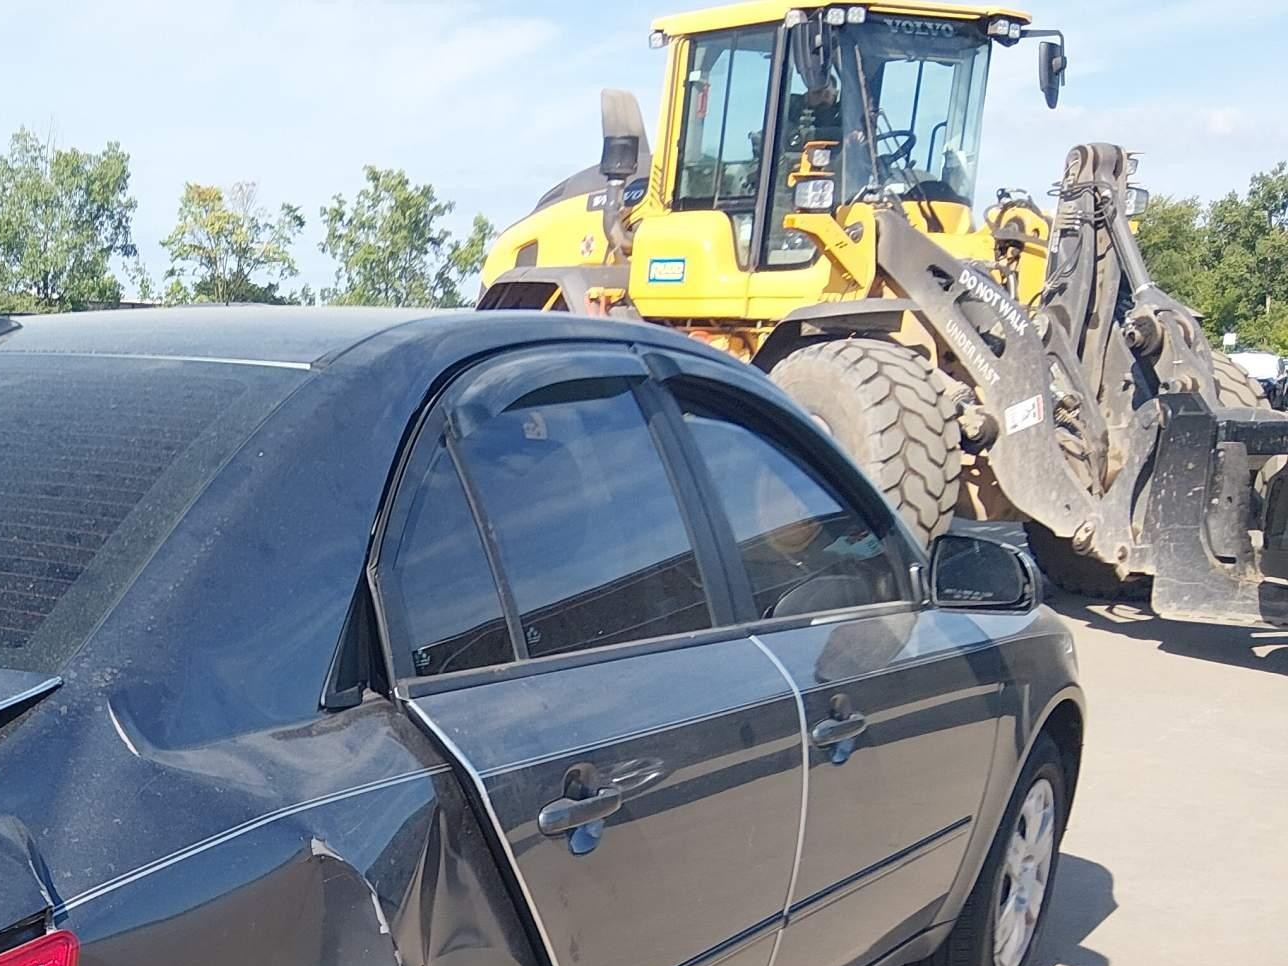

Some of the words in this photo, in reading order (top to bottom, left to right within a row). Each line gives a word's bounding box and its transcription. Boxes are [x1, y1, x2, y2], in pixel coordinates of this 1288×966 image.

[883, 18, 954, 38] VOLVO
[958, 269, 978, 290] DO
[975, 282, 1001, 307] NOT
[998, 300, 1029, 336] WALK
[945, 319, 977, 360] UNDER
[974, 357, 1001, 385] MAST
